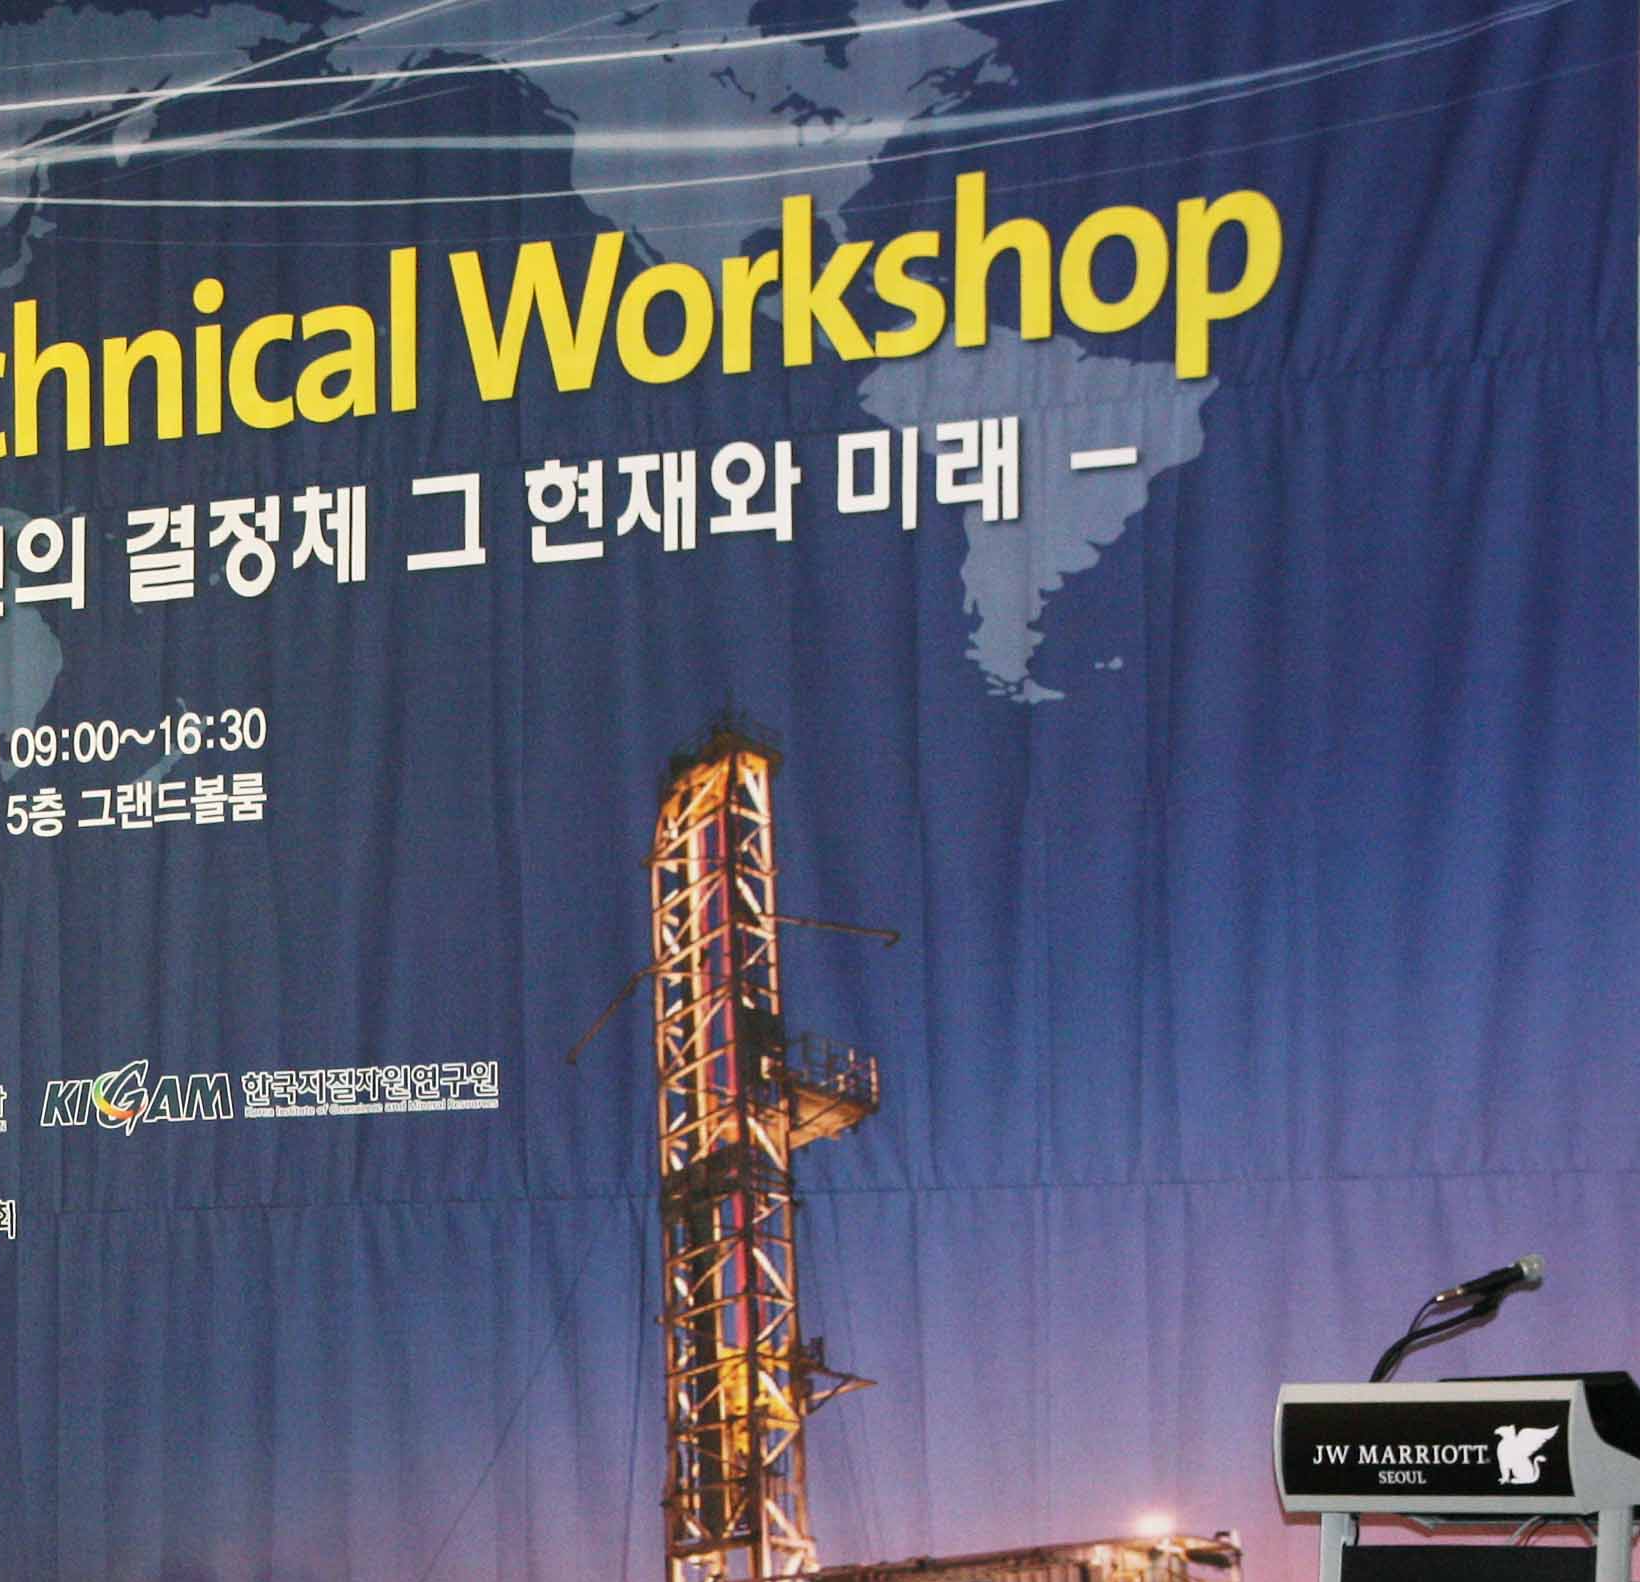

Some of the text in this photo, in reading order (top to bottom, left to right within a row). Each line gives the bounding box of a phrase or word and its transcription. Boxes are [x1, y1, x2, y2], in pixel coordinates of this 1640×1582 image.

[449, 171, 1282, 402] Workshop
[126, 485, 367, 603] 결정체
[407, 472, 486, 571] 그
[524, 440, 802, 563] 현재와
[837, 415, 1020, 530] 미래
[10, 707, 267, 769] 09:00~16:30
[6, 787, 66, 838] 5층
[77, 772, 268, 830] 그랜드볼룸
[40, 1059, 500, 1136] KIGAM 한국지질자원연구원
[1312, 1444, 1488, 1465] JW MARRIOTT
[1378, 1470, 1427, 1485] SEOUL
